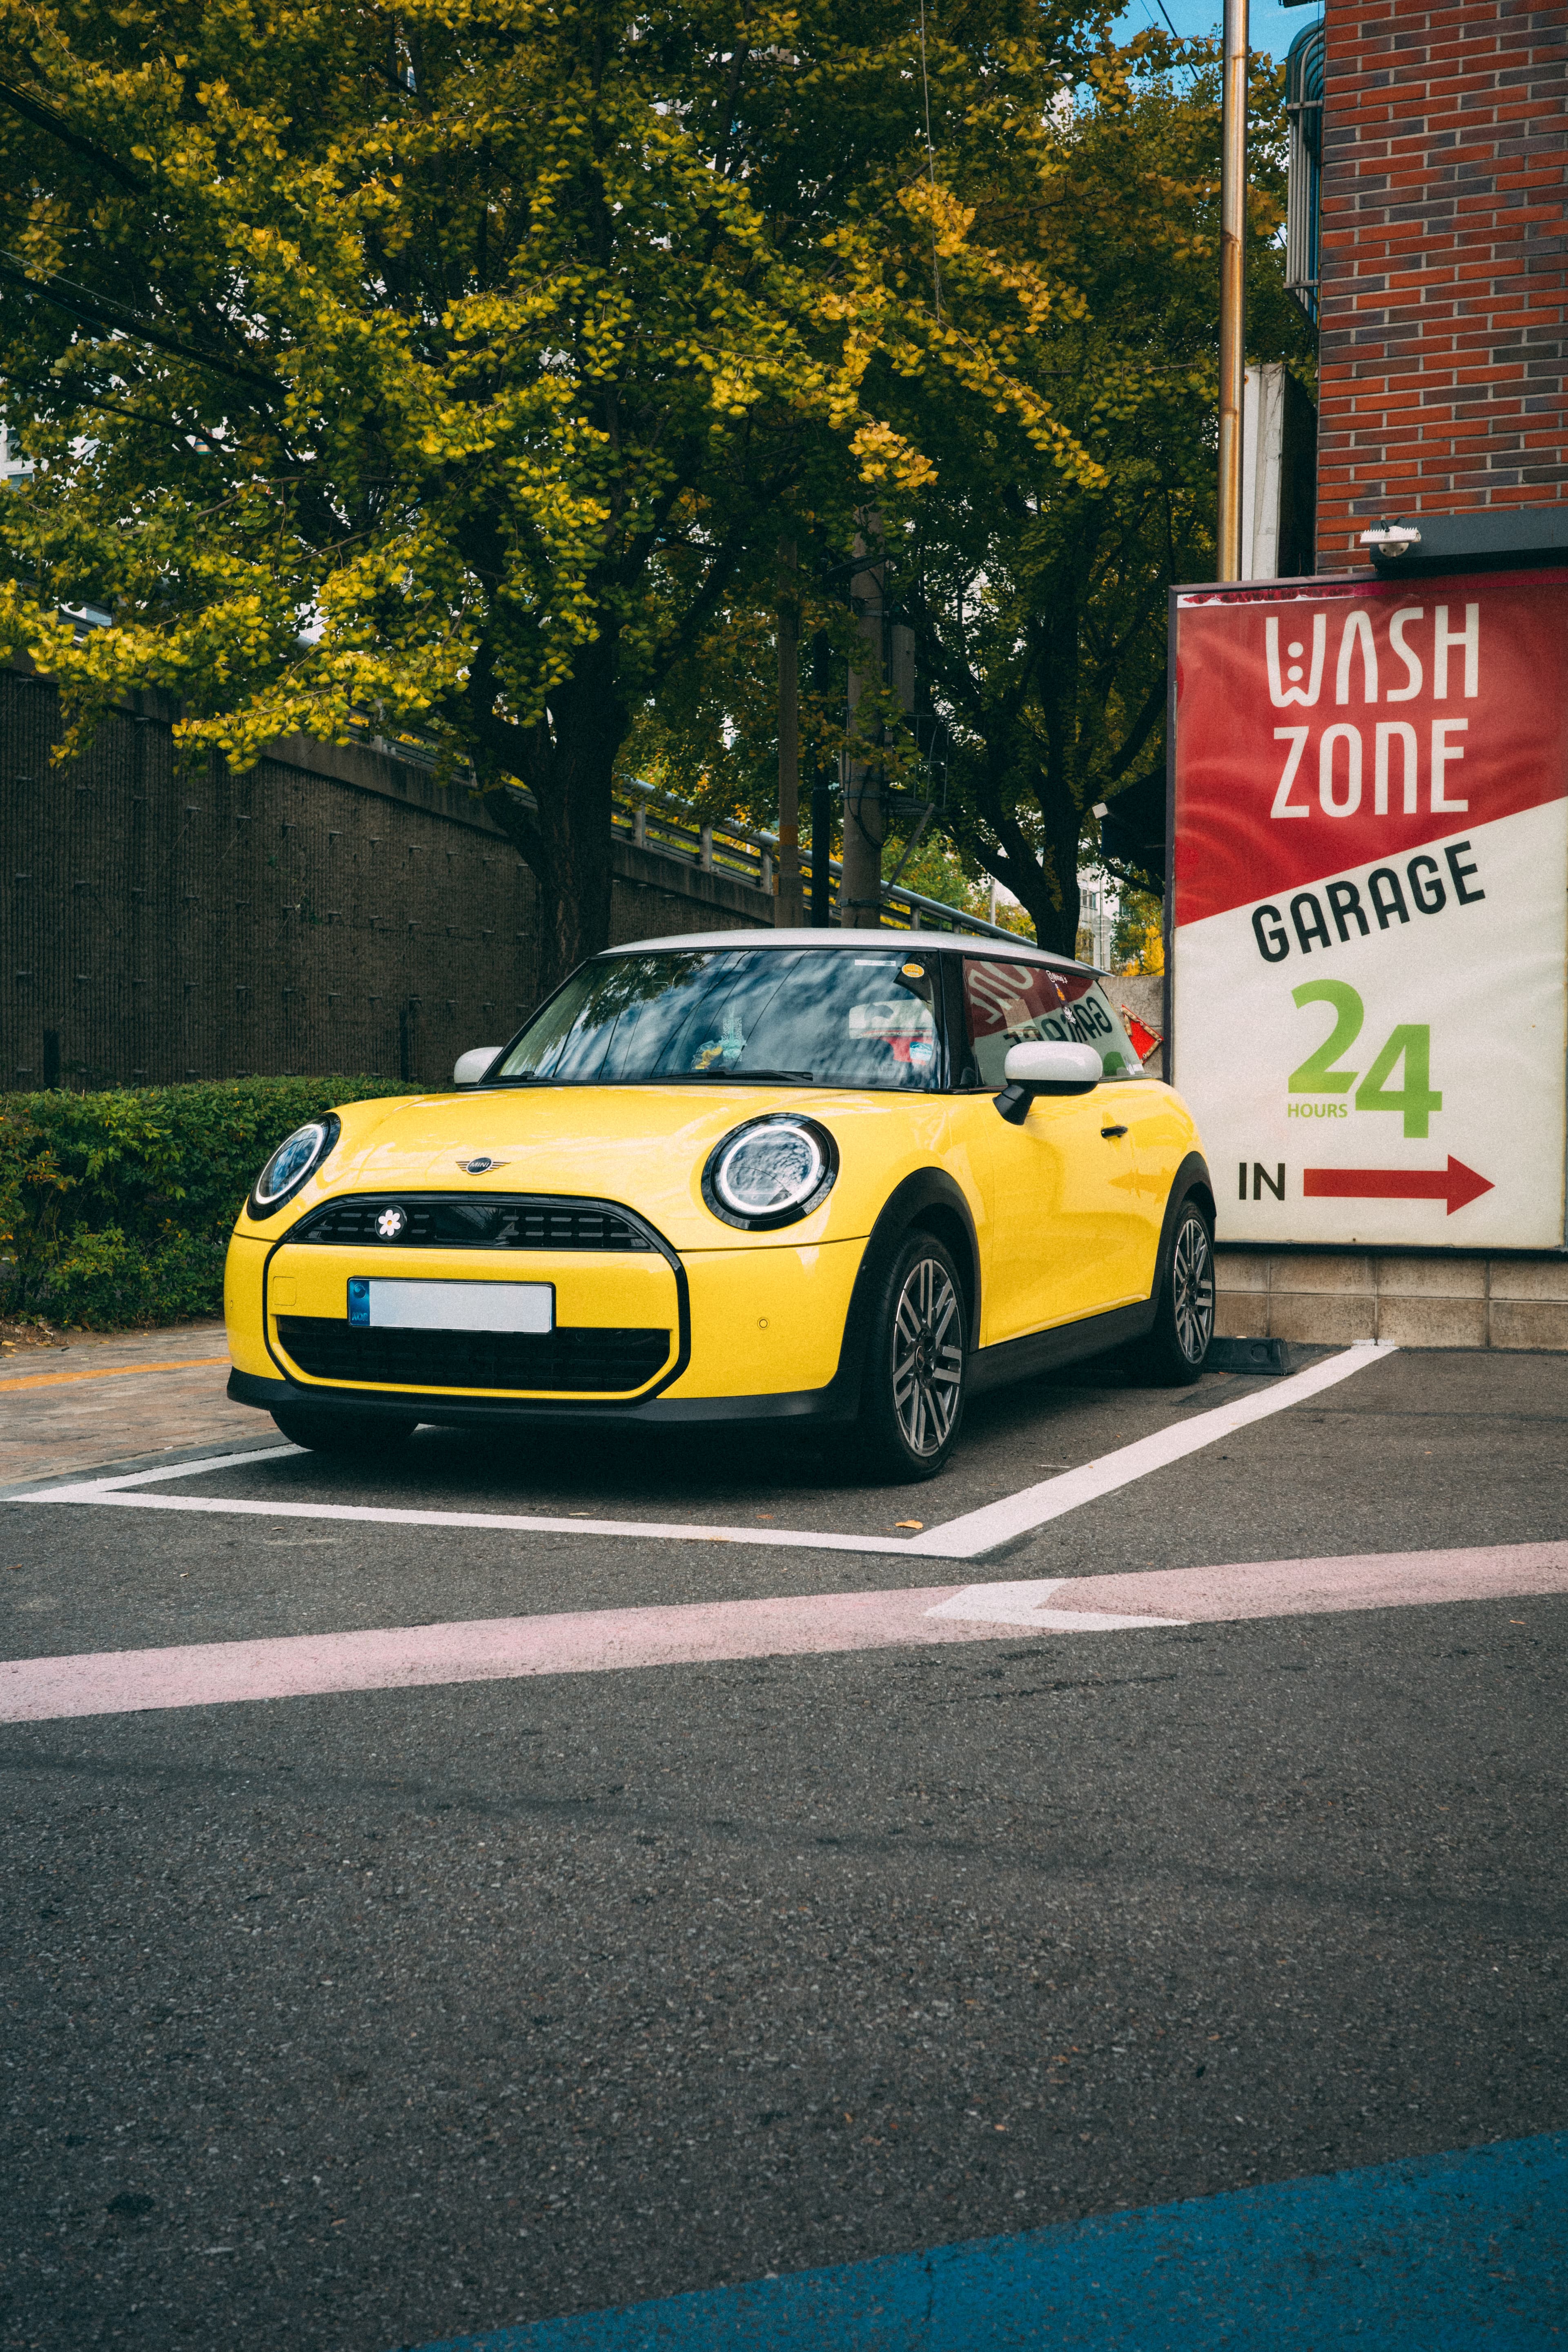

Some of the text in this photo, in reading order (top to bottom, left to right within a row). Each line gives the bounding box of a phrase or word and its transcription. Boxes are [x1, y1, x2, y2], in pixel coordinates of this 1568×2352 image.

[1266, 603, 1479, 708] WASH
[1270, 718, 1469, 819] ZONE
[1251, 840, 1486, 963] GARAGE
[1288, 979, 1443, 1138] 24
[1287, 1103, 1348, 1118] HOURS
[1238, 1162, 1285, 1201] IN
[352, 1312, 368, 1321] KOR
